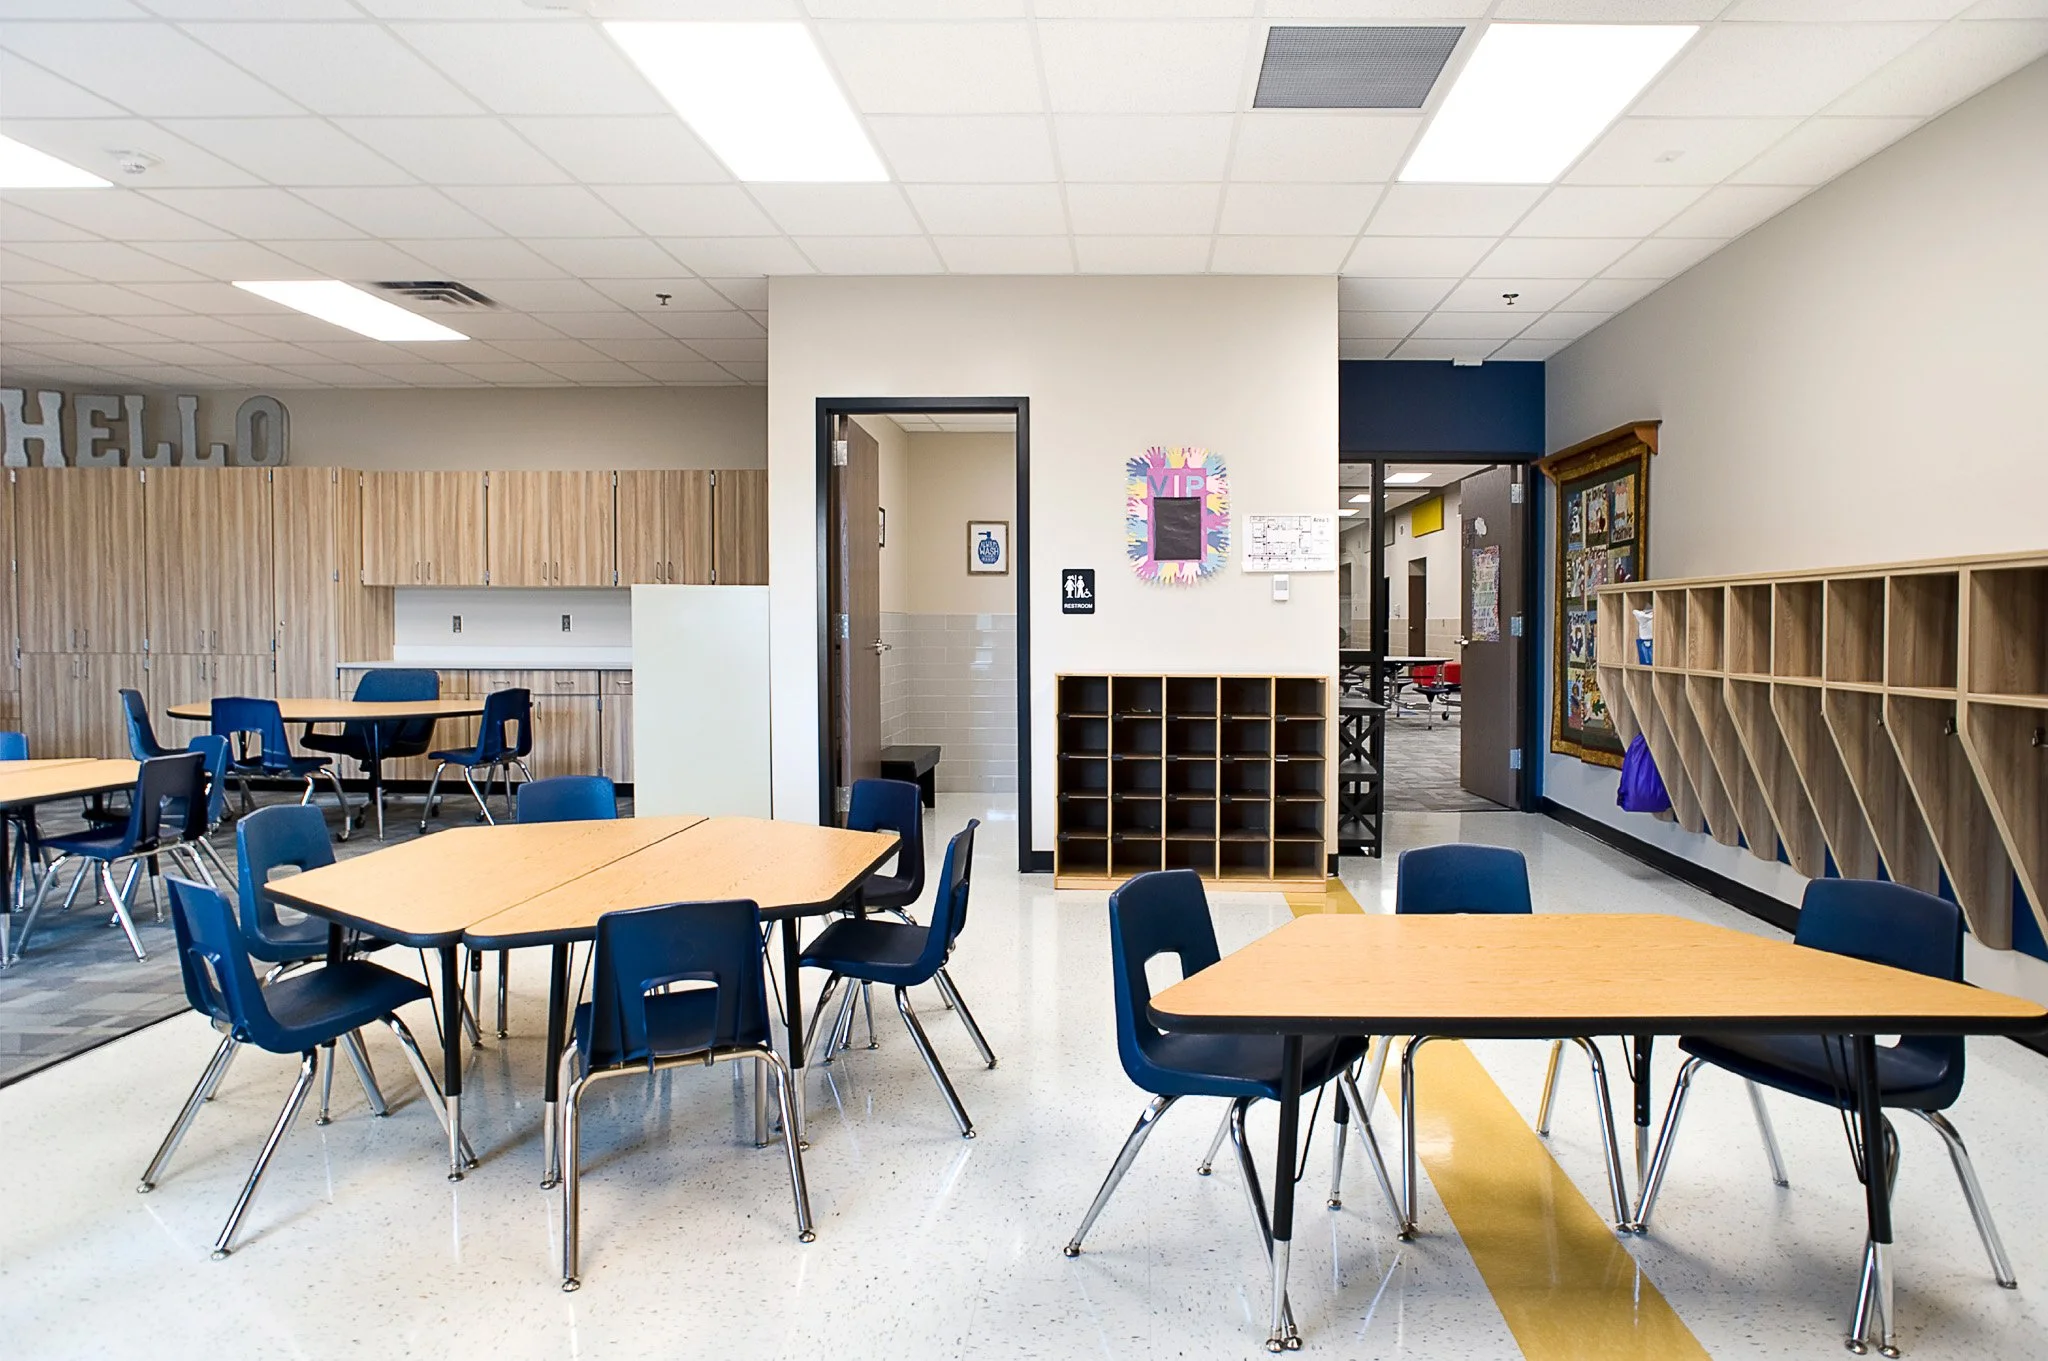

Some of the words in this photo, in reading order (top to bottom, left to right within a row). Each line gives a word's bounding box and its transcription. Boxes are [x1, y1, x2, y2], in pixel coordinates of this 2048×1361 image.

[0, 388, 290, 467] HELLO
[1149, 475, 1205, 498] VIP
[979, 546, 999, 556] WASH
